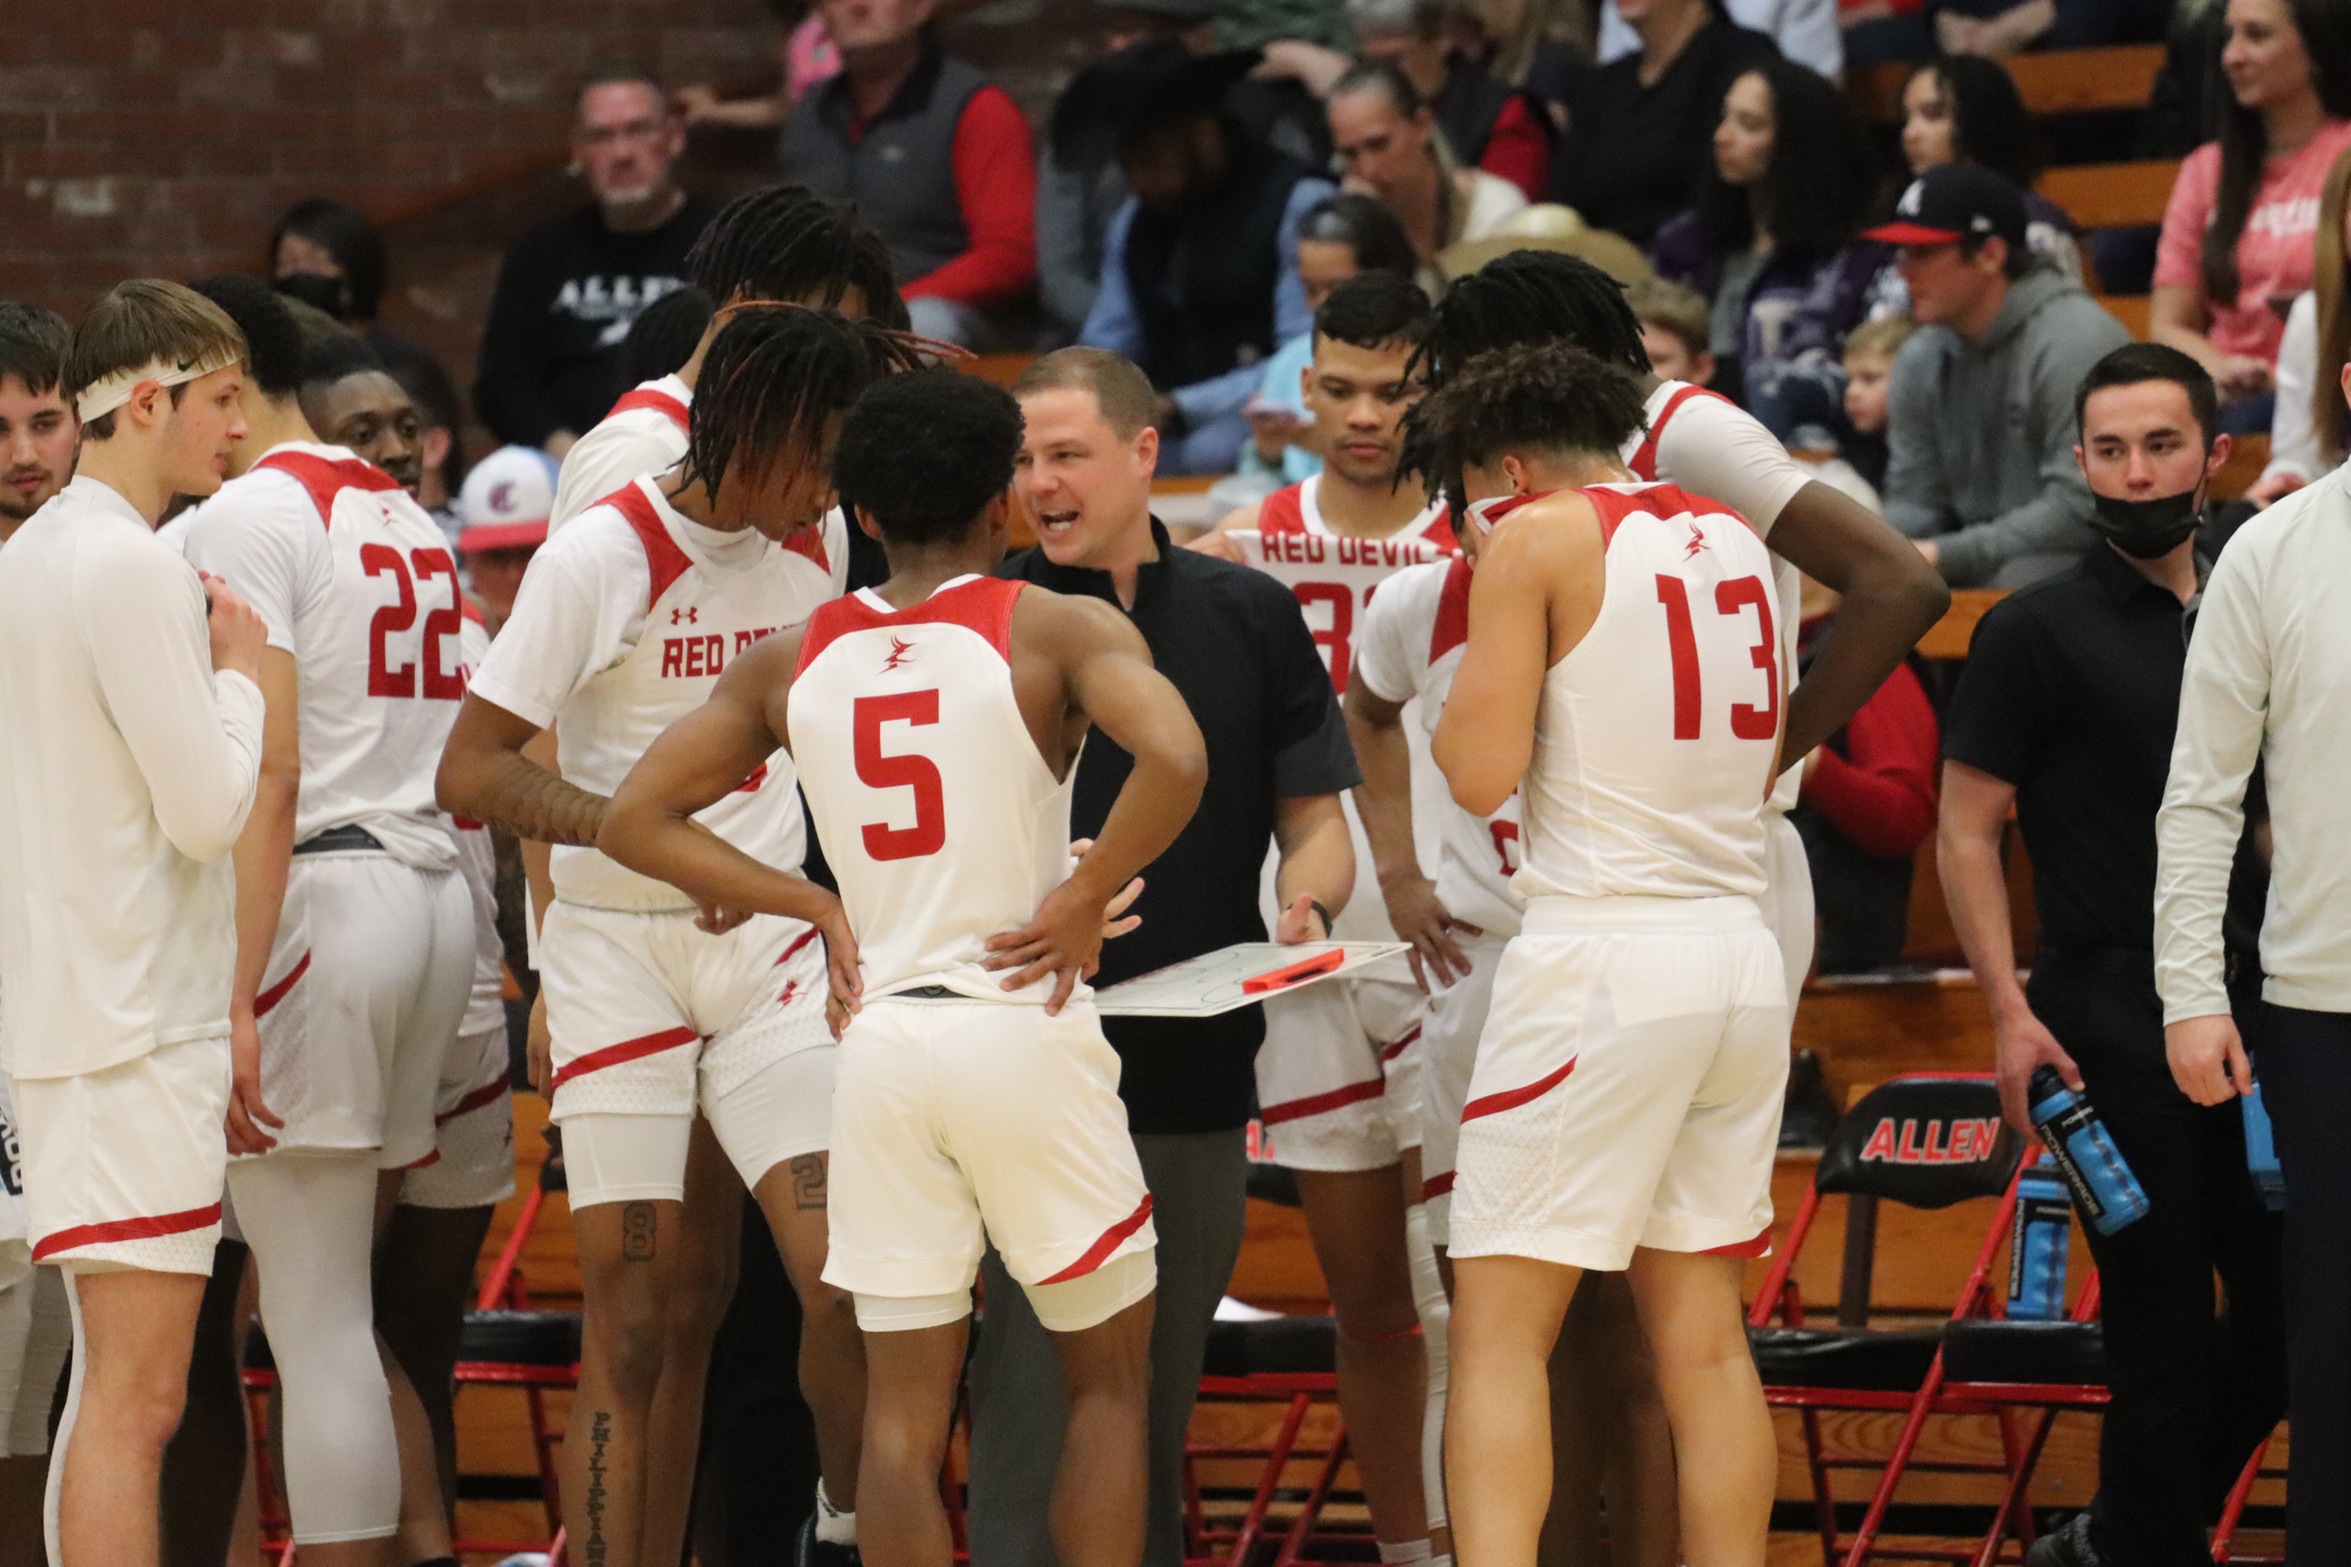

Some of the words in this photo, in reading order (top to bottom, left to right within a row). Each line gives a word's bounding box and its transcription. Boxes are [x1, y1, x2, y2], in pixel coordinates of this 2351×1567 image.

[551, 274, 688, 313] ALLE
[1261, 533, 1325, 564] RED
[360, 543, 462, 701] 22
[661, 634, 724, 678] RED
[1292, 581, 1377, 695] 3
[1655, 573, 1778, 740] 13
[853, 688, 946, 862] 5
[1859, 1117, 2001, 1164] ALLEN
[2040, 1123, 2101, 1217] POWERADE
[623, 1202, 656, 1262] 8
